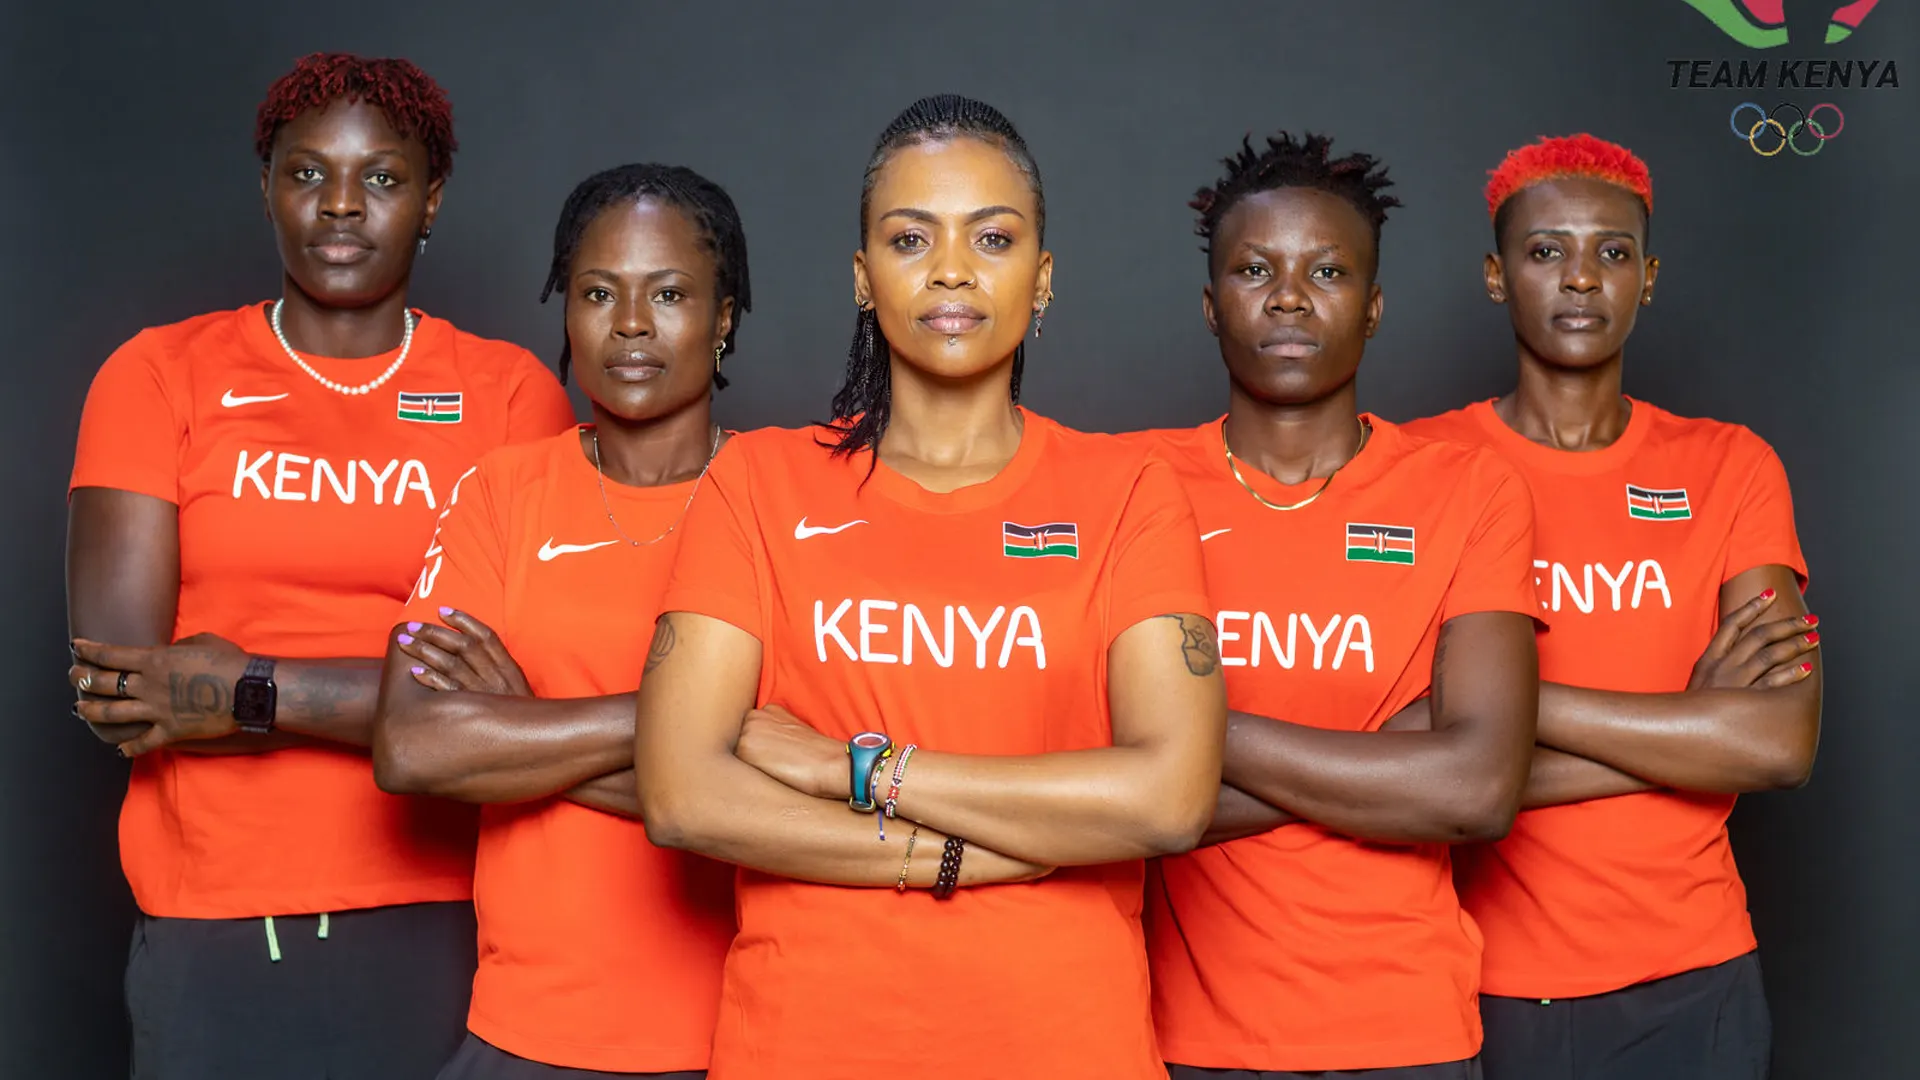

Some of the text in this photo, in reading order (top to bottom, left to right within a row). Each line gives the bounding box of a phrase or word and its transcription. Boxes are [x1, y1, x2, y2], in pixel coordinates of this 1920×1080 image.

[232, 450, 437, 510] KENYA
[1533, 558, 1672, 614] NYA
[813, 598, 1047, 670] KENYA
[1215, 610, 1375, 673] ENYA
